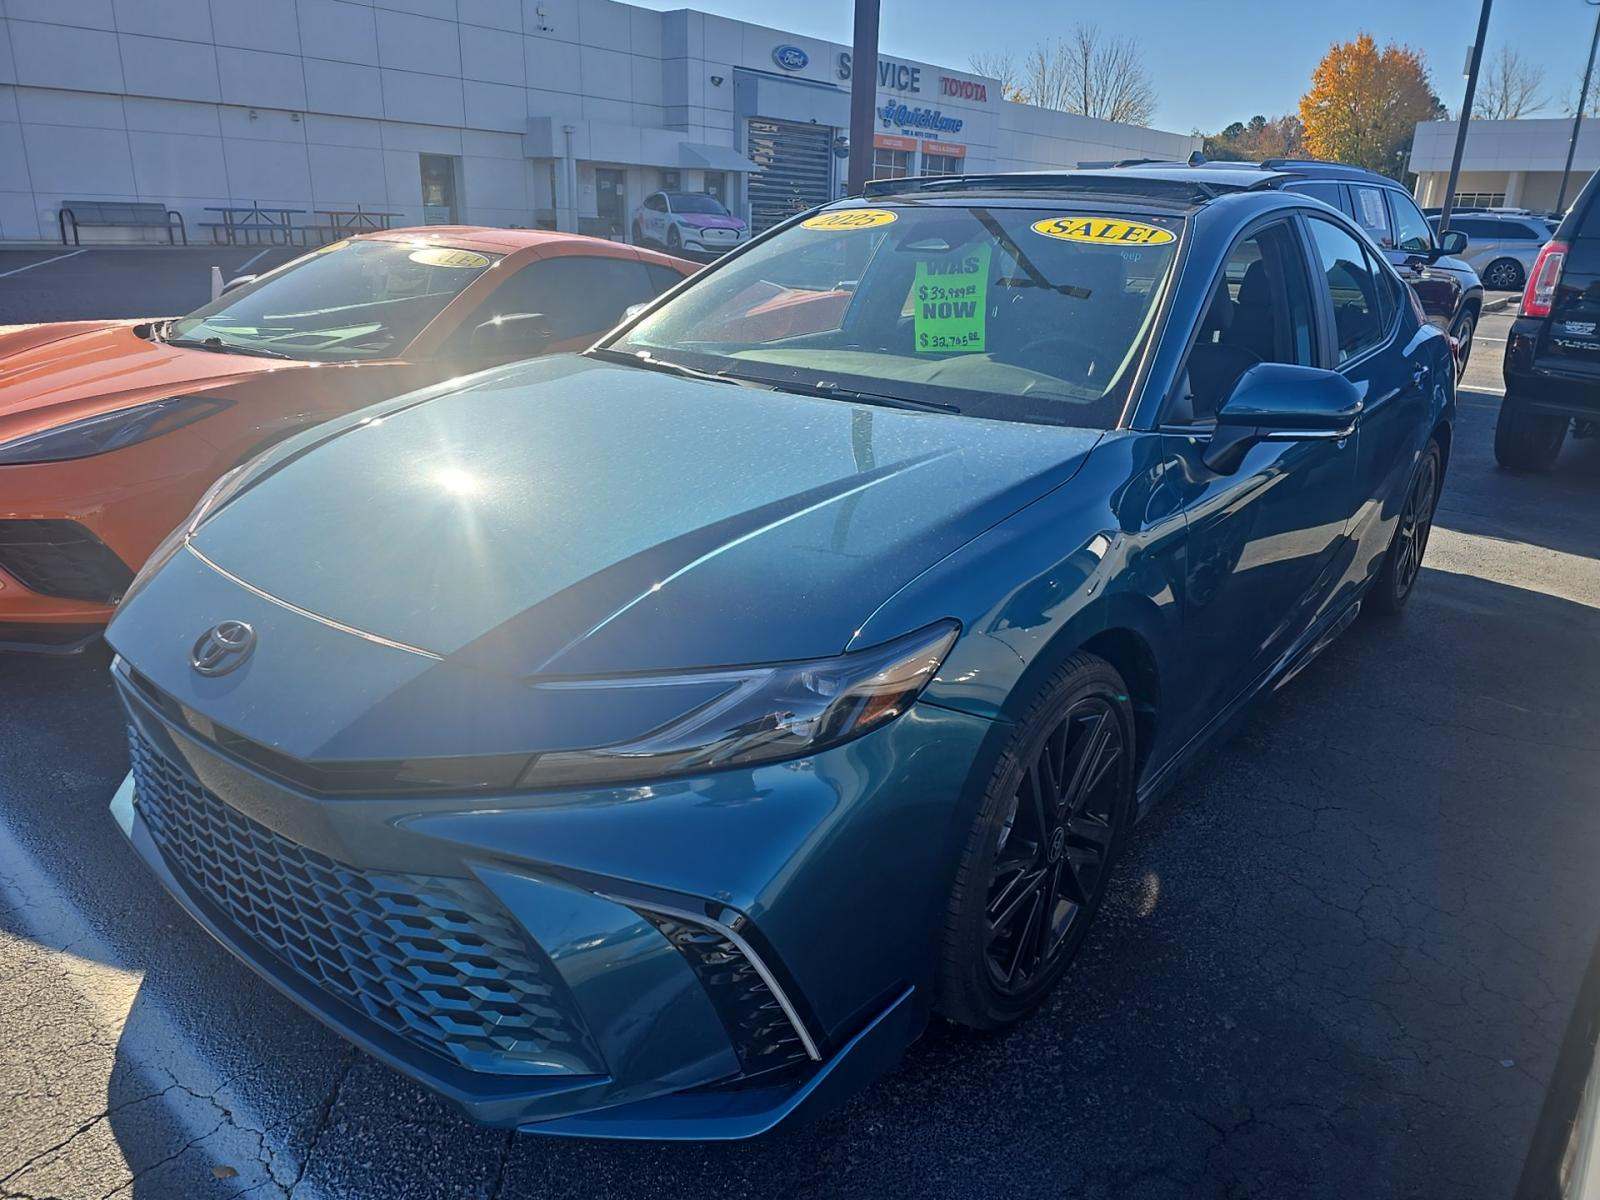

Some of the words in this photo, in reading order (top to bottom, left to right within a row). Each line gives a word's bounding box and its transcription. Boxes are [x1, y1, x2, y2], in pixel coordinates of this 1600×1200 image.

[838, 52, 921, 93] SVICE
[941, 76, 987, 102] TOYOTA
[1048, 219, 1156, 243] SALE!
[926, 257, 980, 276] WAS
[922, 301, 977, 320] NOW
